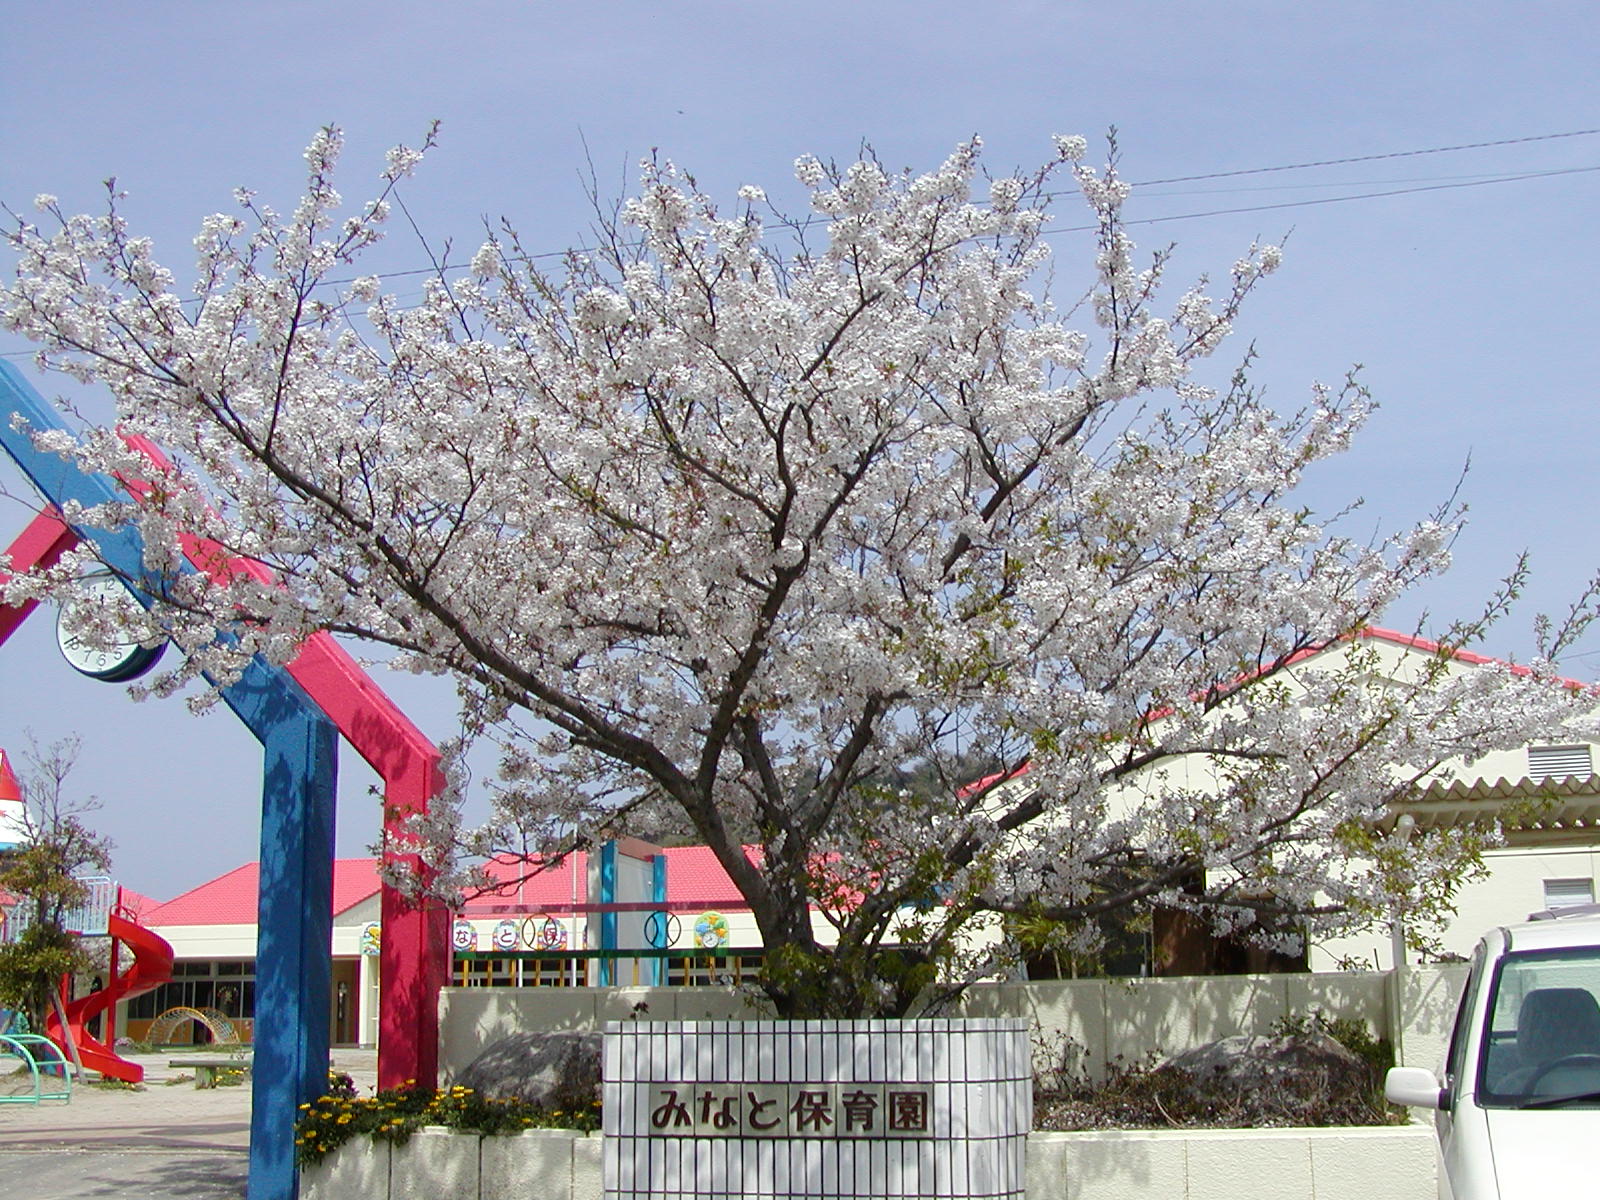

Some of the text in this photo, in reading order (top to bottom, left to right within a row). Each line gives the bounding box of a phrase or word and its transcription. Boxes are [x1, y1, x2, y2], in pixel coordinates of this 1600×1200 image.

[104, 578, 116, 590] 12
[84, 650, 91, 662] 7
[113, 648, 122, 660] 5
[97, 654, 106, 667] 6
[651, 1090, 928, 1131] みなと保育園
